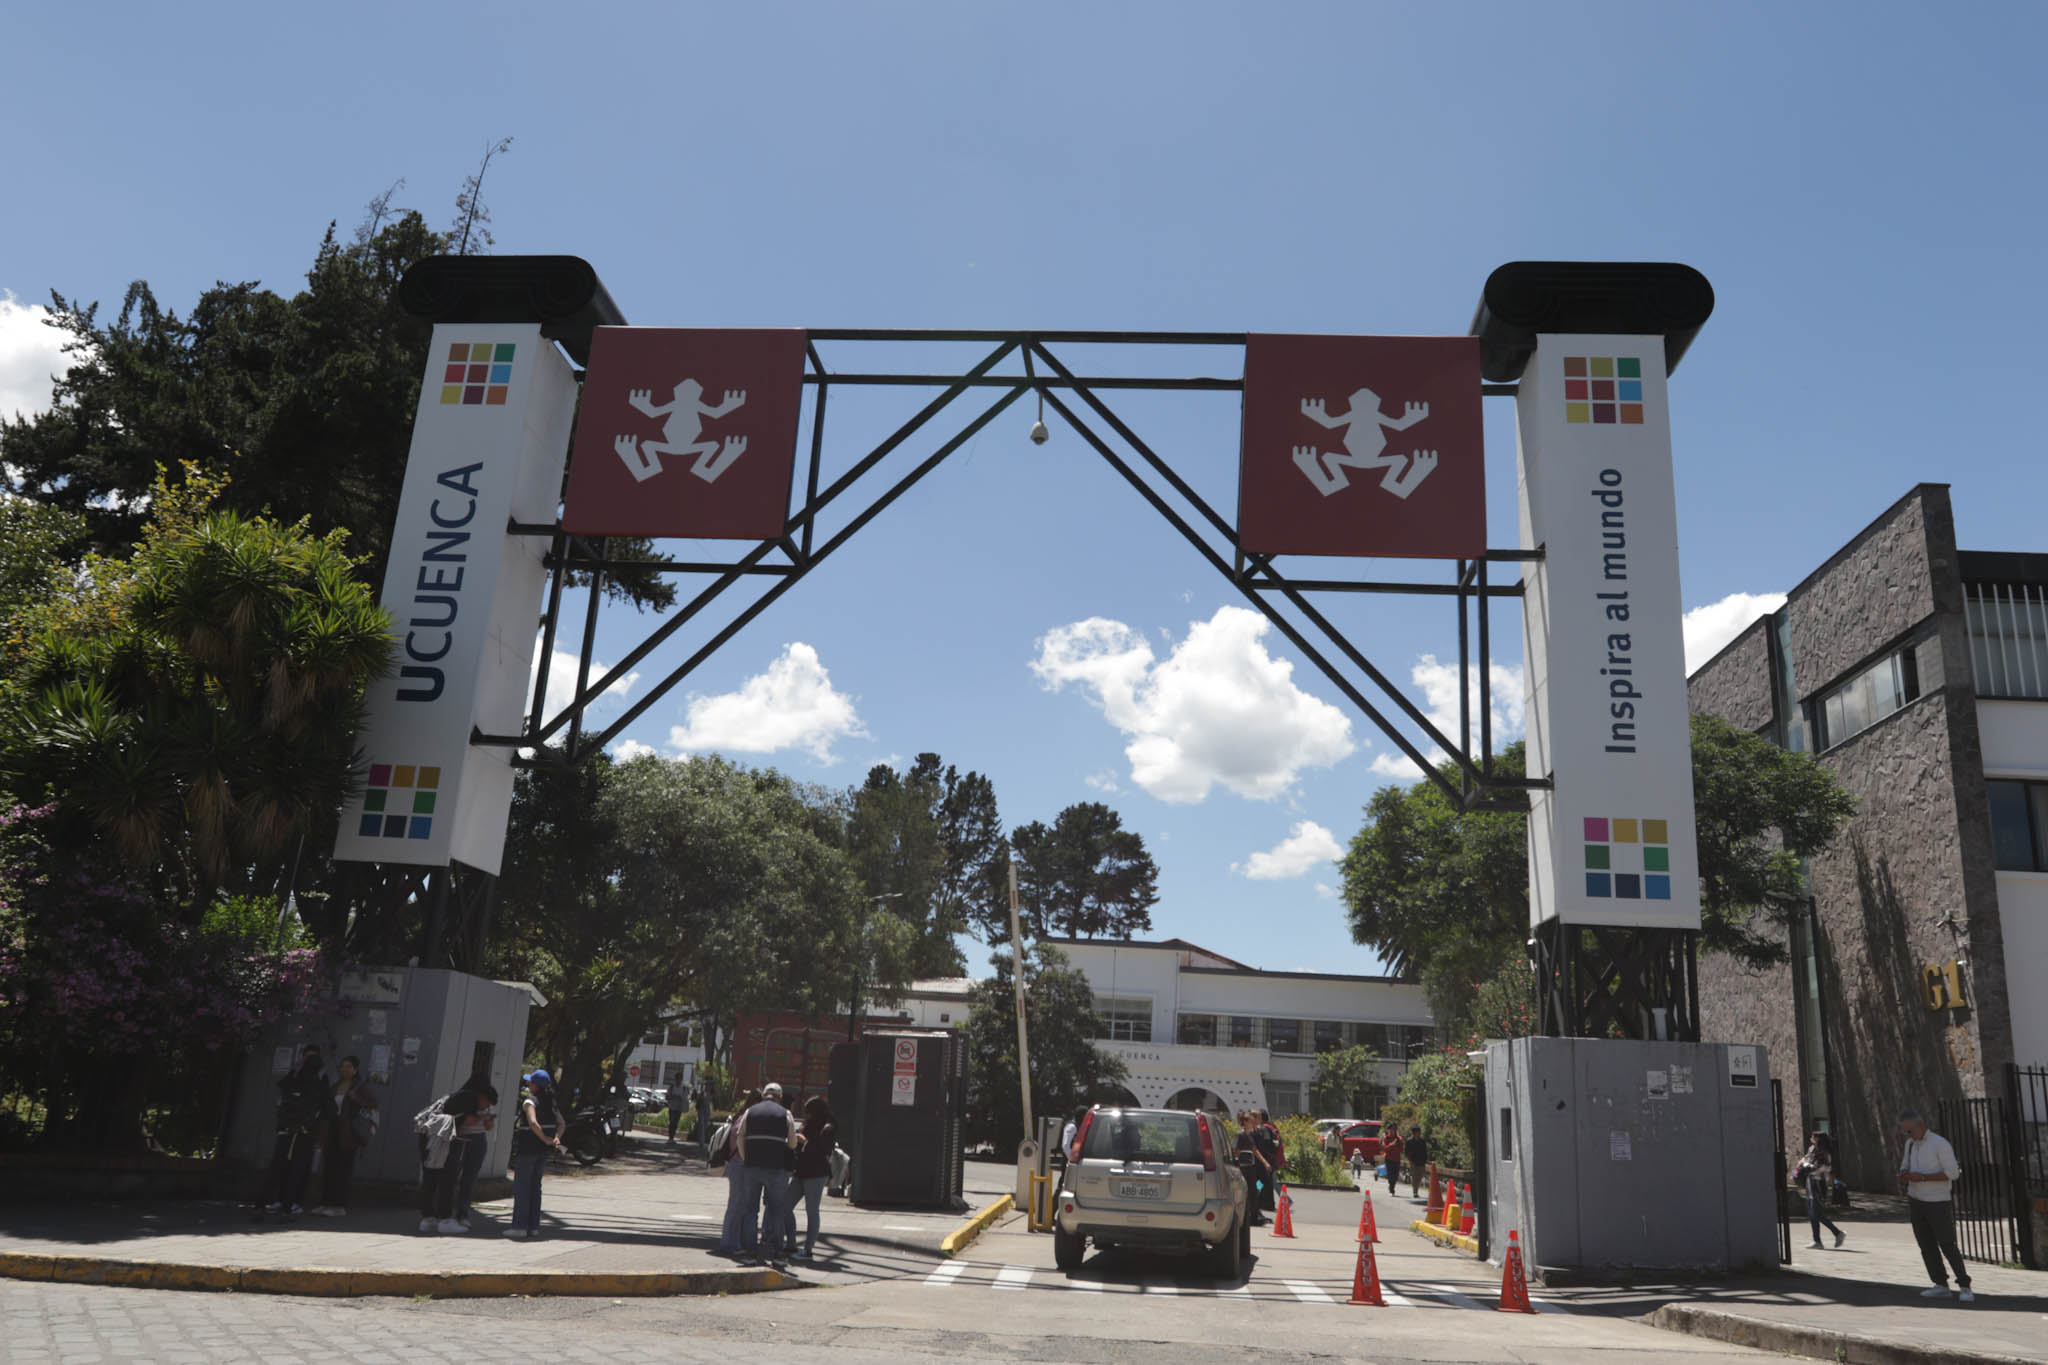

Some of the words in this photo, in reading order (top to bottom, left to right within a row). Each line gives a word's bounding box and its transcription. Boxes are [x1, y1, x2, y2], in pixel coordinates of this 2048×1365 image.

[1591, 468, 1628, 580] mundo
[395, 461, 484, 702] UCUENCA
[1596, 591, 1631, 622] al
[1599, 632, 1642, 754] Inspira
[1922, 960, 1968, 1010] G1
[1119, 1049, 1161, 1061] CUENCA
